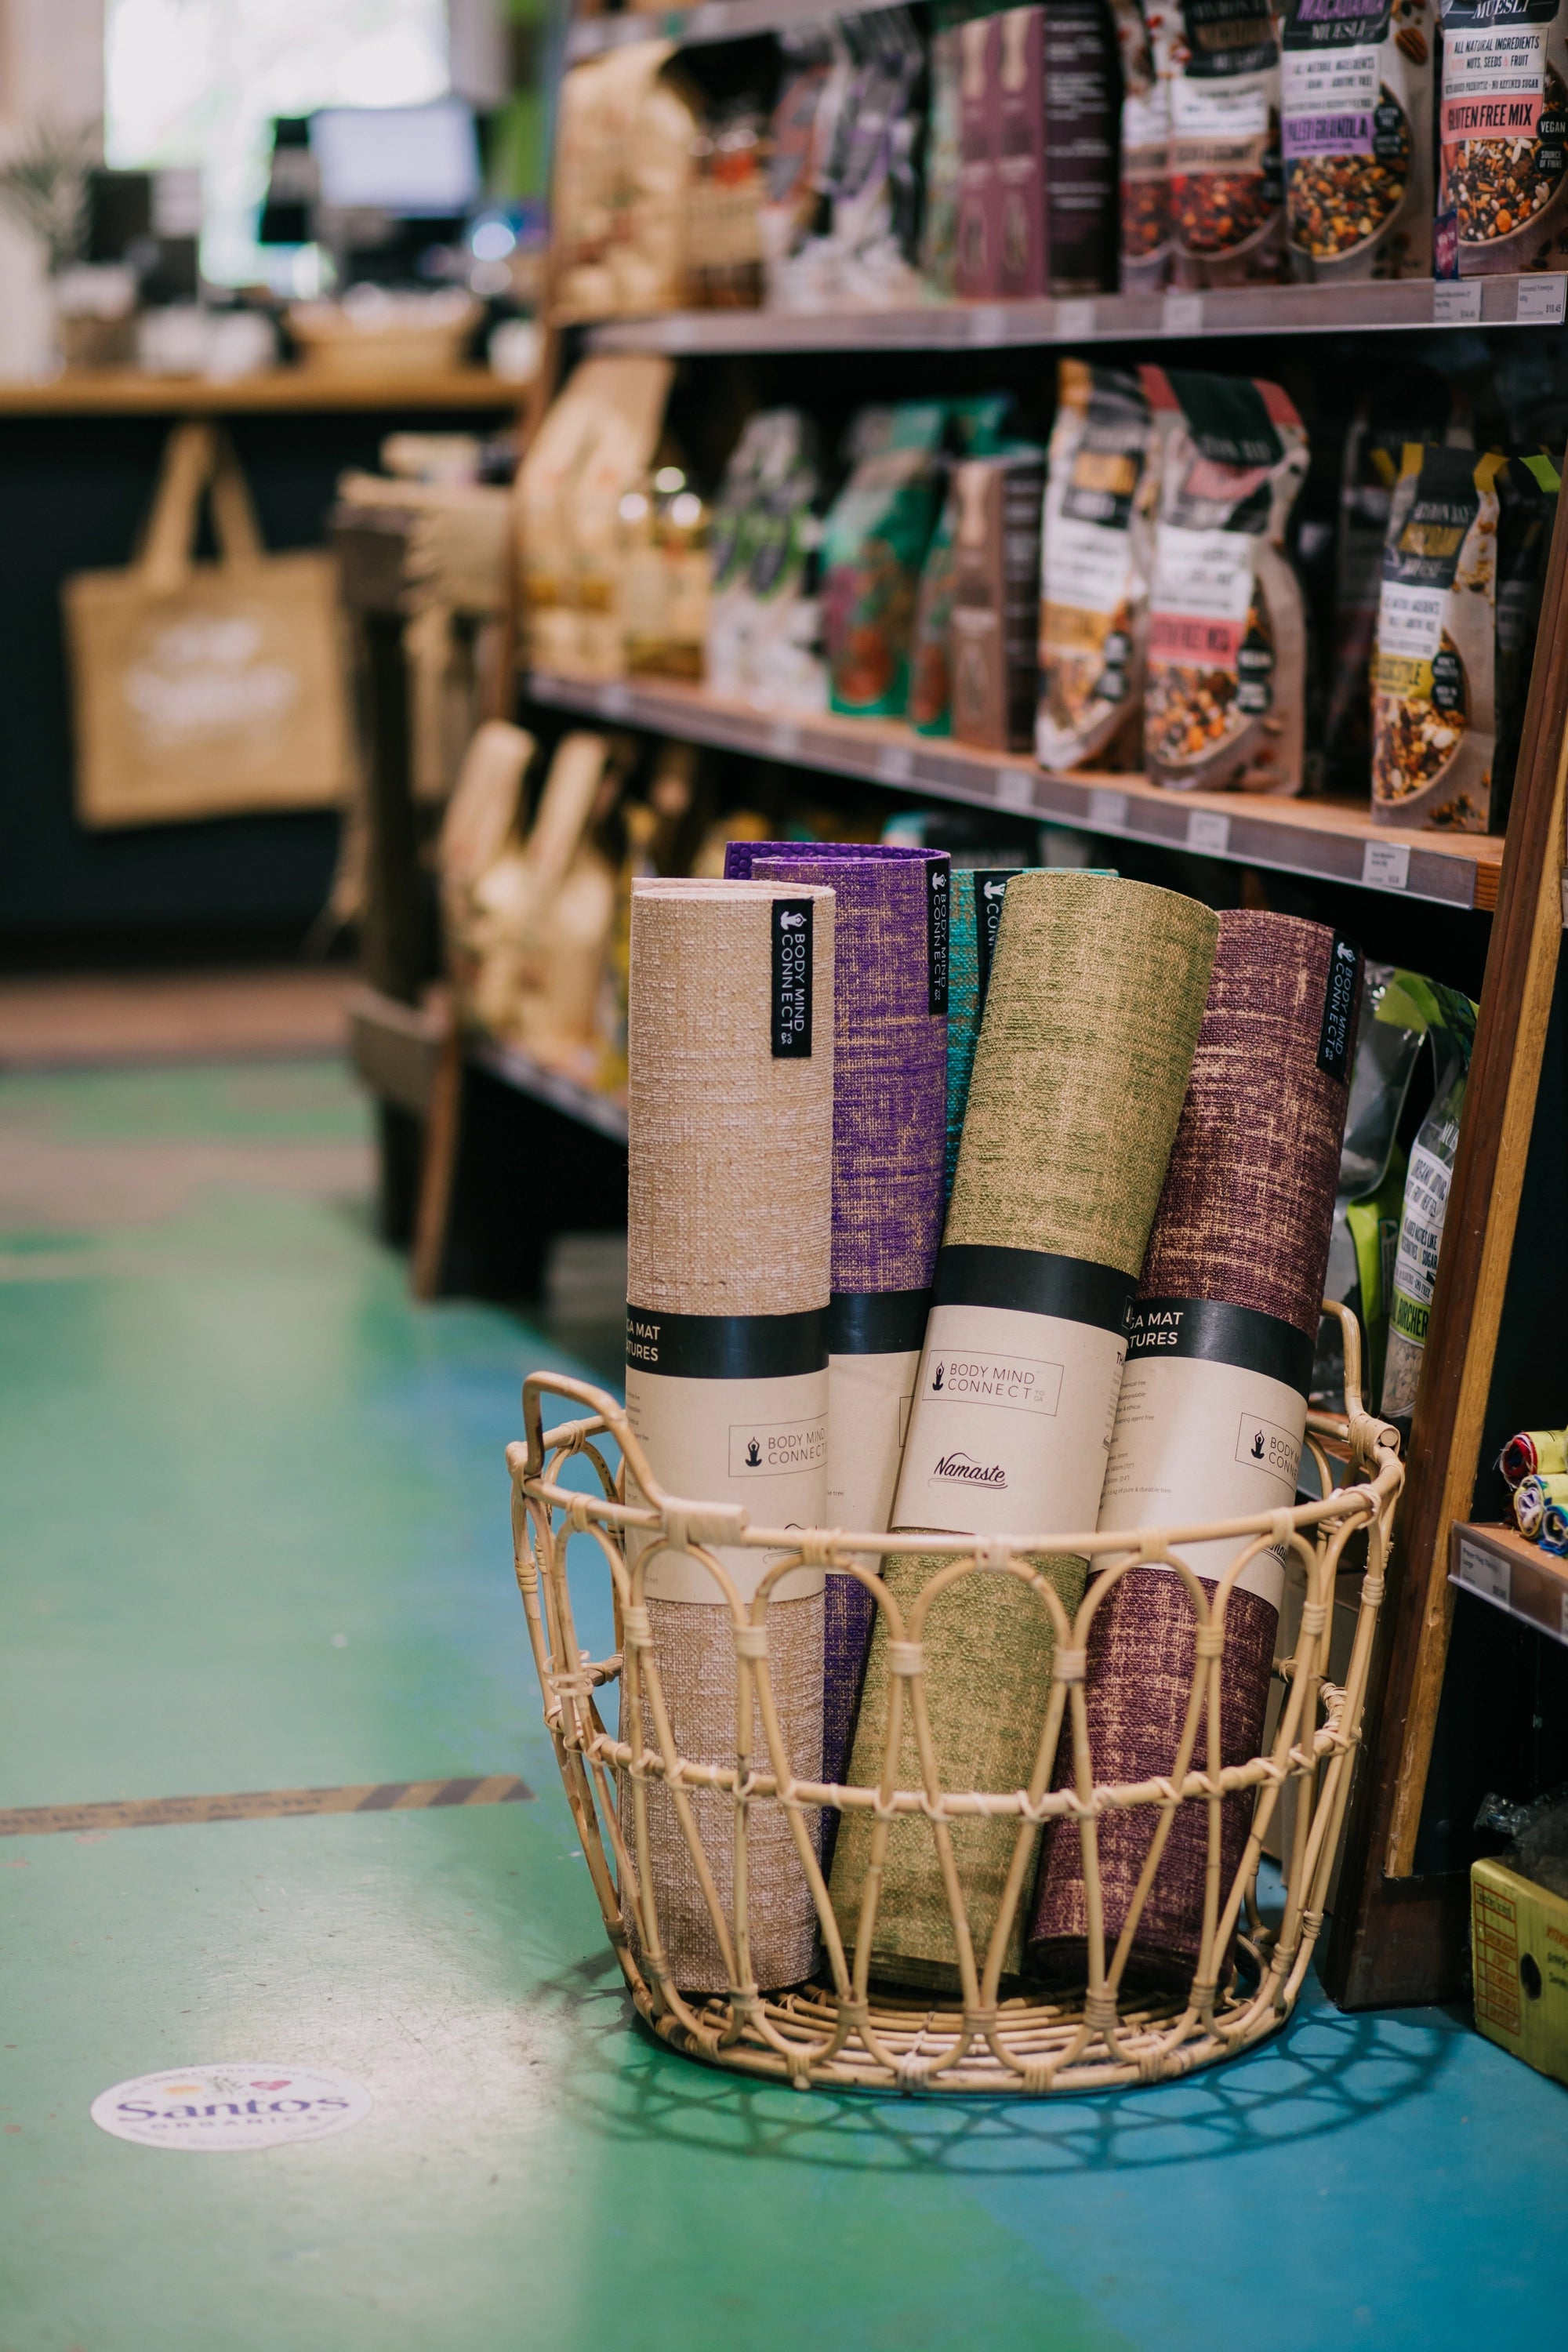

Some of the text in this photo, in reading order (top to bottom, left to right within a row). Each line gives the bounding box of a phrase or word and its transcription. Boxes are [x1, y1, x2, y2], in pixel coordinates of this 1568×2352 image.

[1471, 0, 1529, 20] MUESLI
[1454, 35, 1540, 54] ALL NATURAL INGREDIENTS
[1483, 56, 1502, 67] SEEDS
[1510, 55, 1529, 67] FRUIT
[1499, 80, 1521, 89] REFINED
[1522, 78, 1539, 89] SUGAR
[1448, 103, 1534, 131] GLUTEN FREE MIX
[1541, 121, 1566, 133] VEGAN
[1541, 150, 1561, 159] SOURCE
[1546, 157, 1563, 169] FIBRE
[781, 934, 793, 1030] CONNECT
[793, 934, 805, 1032] BODY MIND
[1327, 962, 1345, 1049] CONNECT
[1335, 967, 1353, 1054] BODY MIND
[1427, 1232, 1438, 1250] LIKE
[1421, 1250, 1438, 1270] SUGAR
[1148, 1312, 1184, 1326] MAT
[1397, 1298, 1429, 1339] BIRCHER
[636, 1322, 661, 1341] MAT
[949, 1363, 1035, 1385] BODY MIND
[948, 1378, 1032, 1399] CONNECT
[768, 1428, 826, 1450] BODY MIND
[1270, 1436, 1294, 1457] BODY
[933, 1452, 1006, 1483] Namaste
[117, 2098, 350, 2122] Santos
[151, 2115, 319, 2129] ORGANICS
